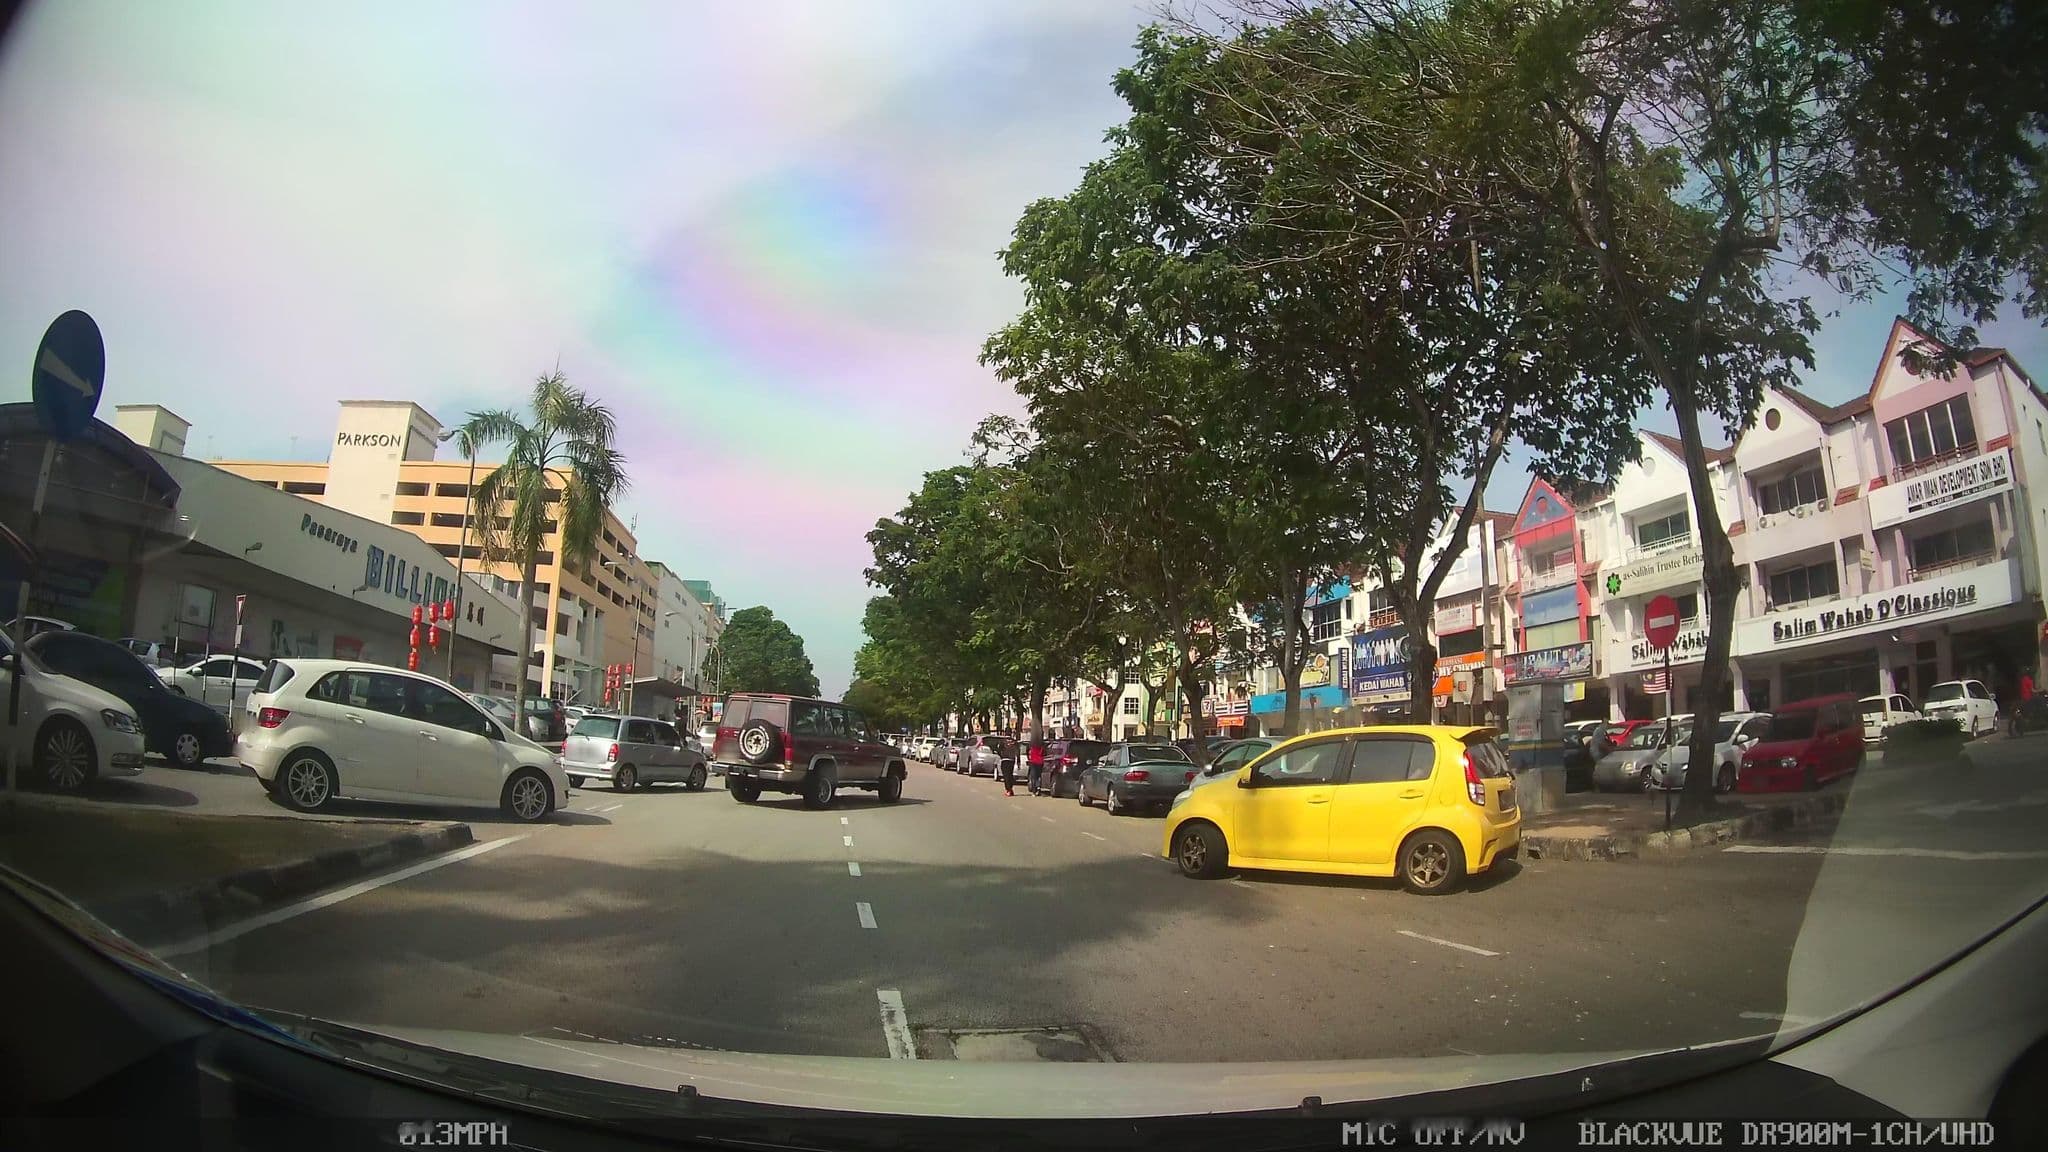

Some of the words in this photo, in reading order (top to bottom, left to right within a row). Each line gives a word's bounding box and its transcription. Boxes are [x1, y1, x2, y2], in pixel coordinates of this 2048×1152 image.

[338, 432, 401, 447] PARKSON
[1906, 482, 1923, 505] AMAR
[1923, 477, 1939, 499] IMAN
[1939, 464, 1979, 494] DEVELOPMENT
[1979, 460, 1993, 482] SDN
[1994, 455, 2006, 478] BHD
[301, 513, 359, 553] Pasaraya
[1657, 560, 1681, 573] Trustee
[1773, 618, 1817, 641] Salim
[1820, 603, 1874, 632] Wahab
[1877, 584, 1977, 620] D'Classique
[1359, 681, 1379, 691] KEDAI
[1380, 677, 1404, 688] WAHAB
